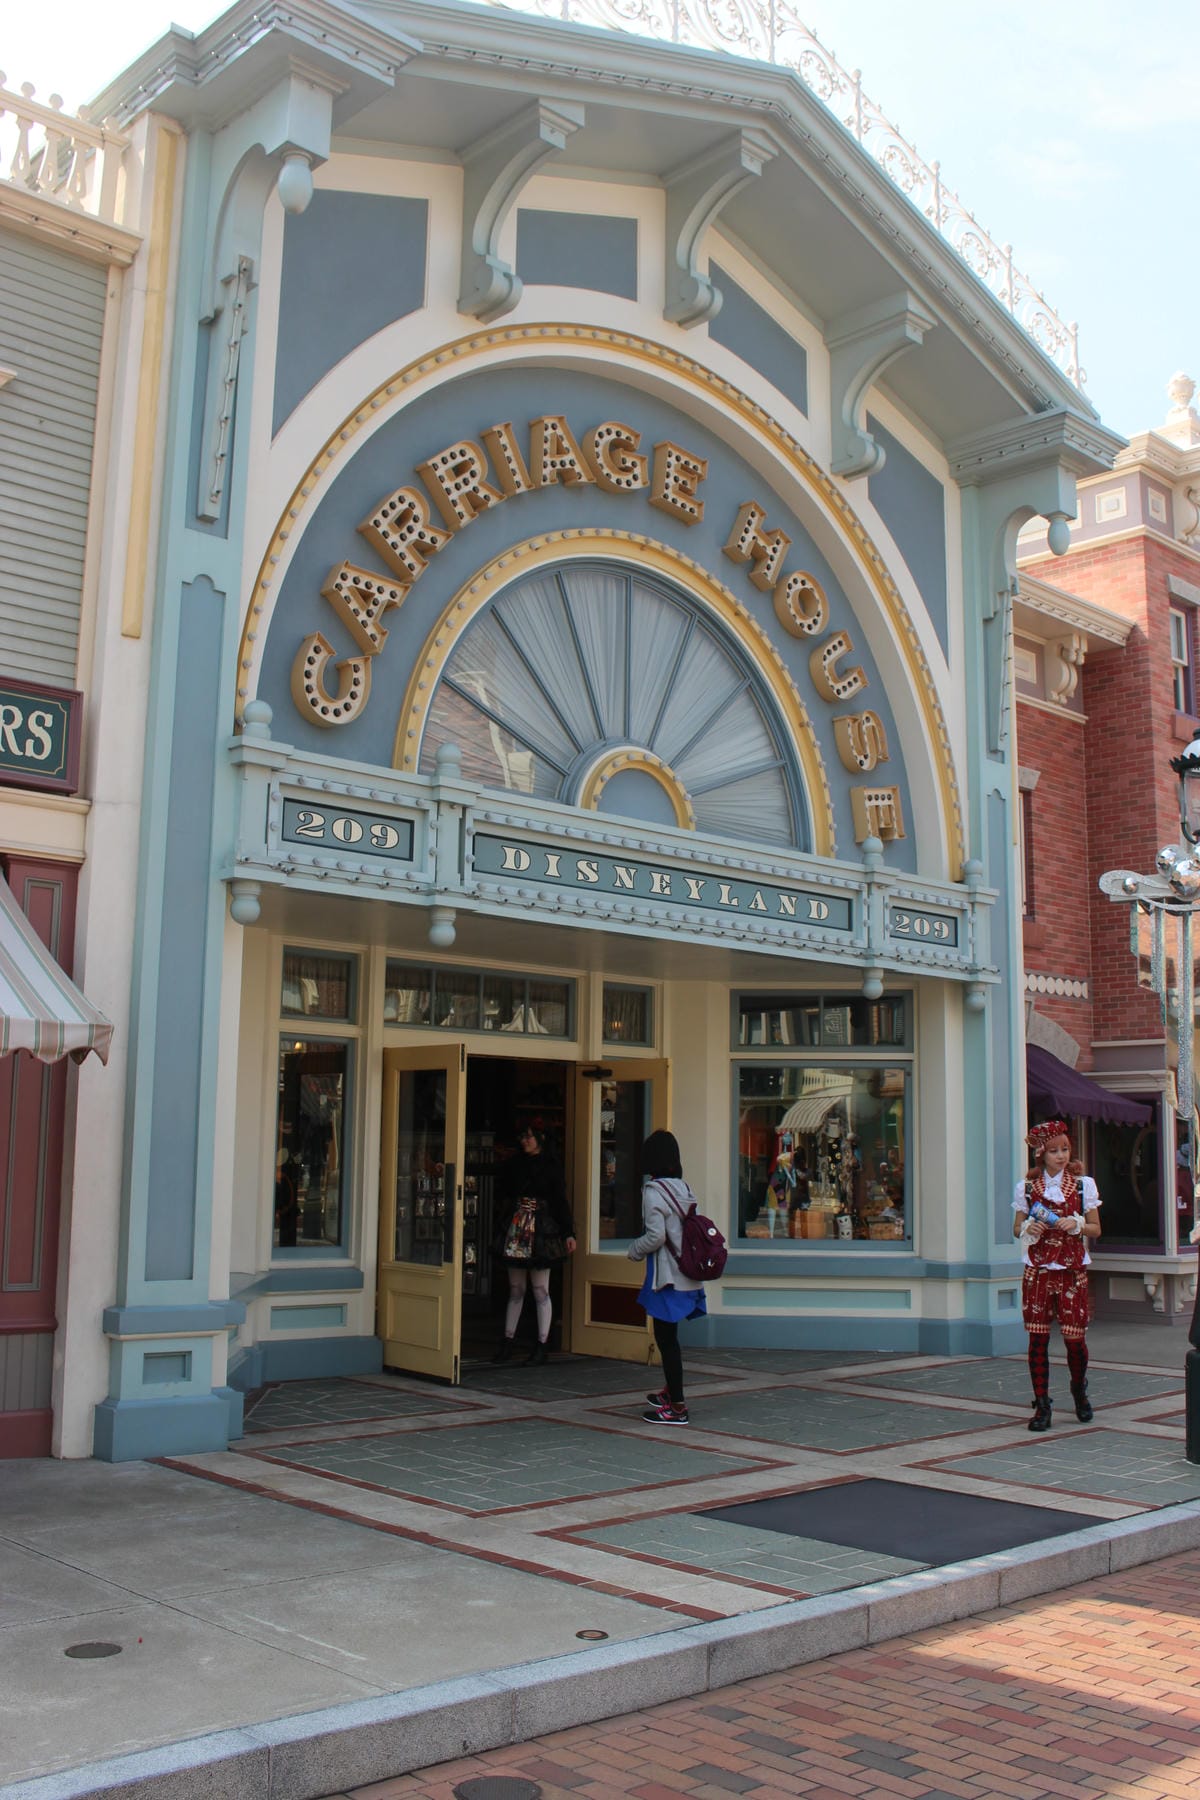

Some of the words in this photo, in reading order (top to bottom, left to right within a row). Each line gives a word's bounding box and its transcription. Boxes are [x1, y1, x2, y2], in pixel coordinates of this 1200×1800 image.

[291, 416, 708, 727] CARRIAGE
[722, 500, 906, 843] HOUSE
[295, 810, 399, 849] 209
[502, 846, 830, 921] DISNEYLAND
[895, 914, 950, 939] 209
